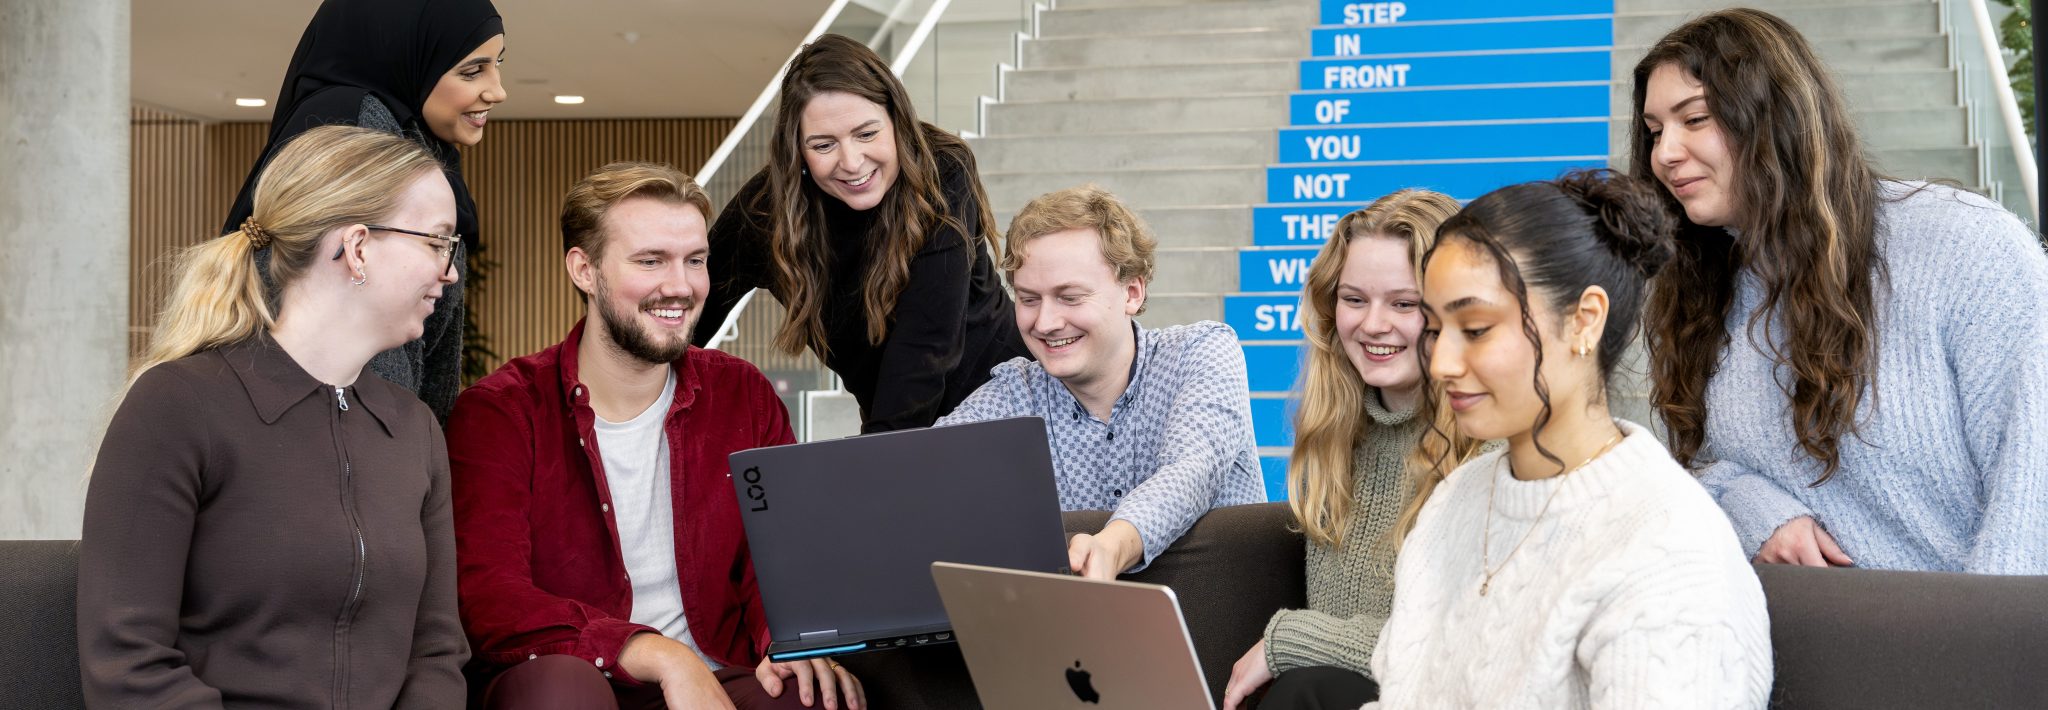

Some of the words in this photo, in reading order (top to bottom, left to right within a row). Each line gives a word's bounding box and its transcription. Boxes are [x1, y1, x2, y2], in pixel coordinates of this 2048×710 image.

[1343, 2, 1407, 25] STEP
[1334, 34, 1361, 56] IN
[1324, 63, 1411, 89] FRONT
[1315, 99, 1351, 124] OF
[1305, 135, 1361, 160] YOU
[1293, 173, 1351, 199] NOT
[1281, 214, 1340, 240] THE
[1268, 258, 1314, 284] WH
[743, 466, 768, 512] LOQ
